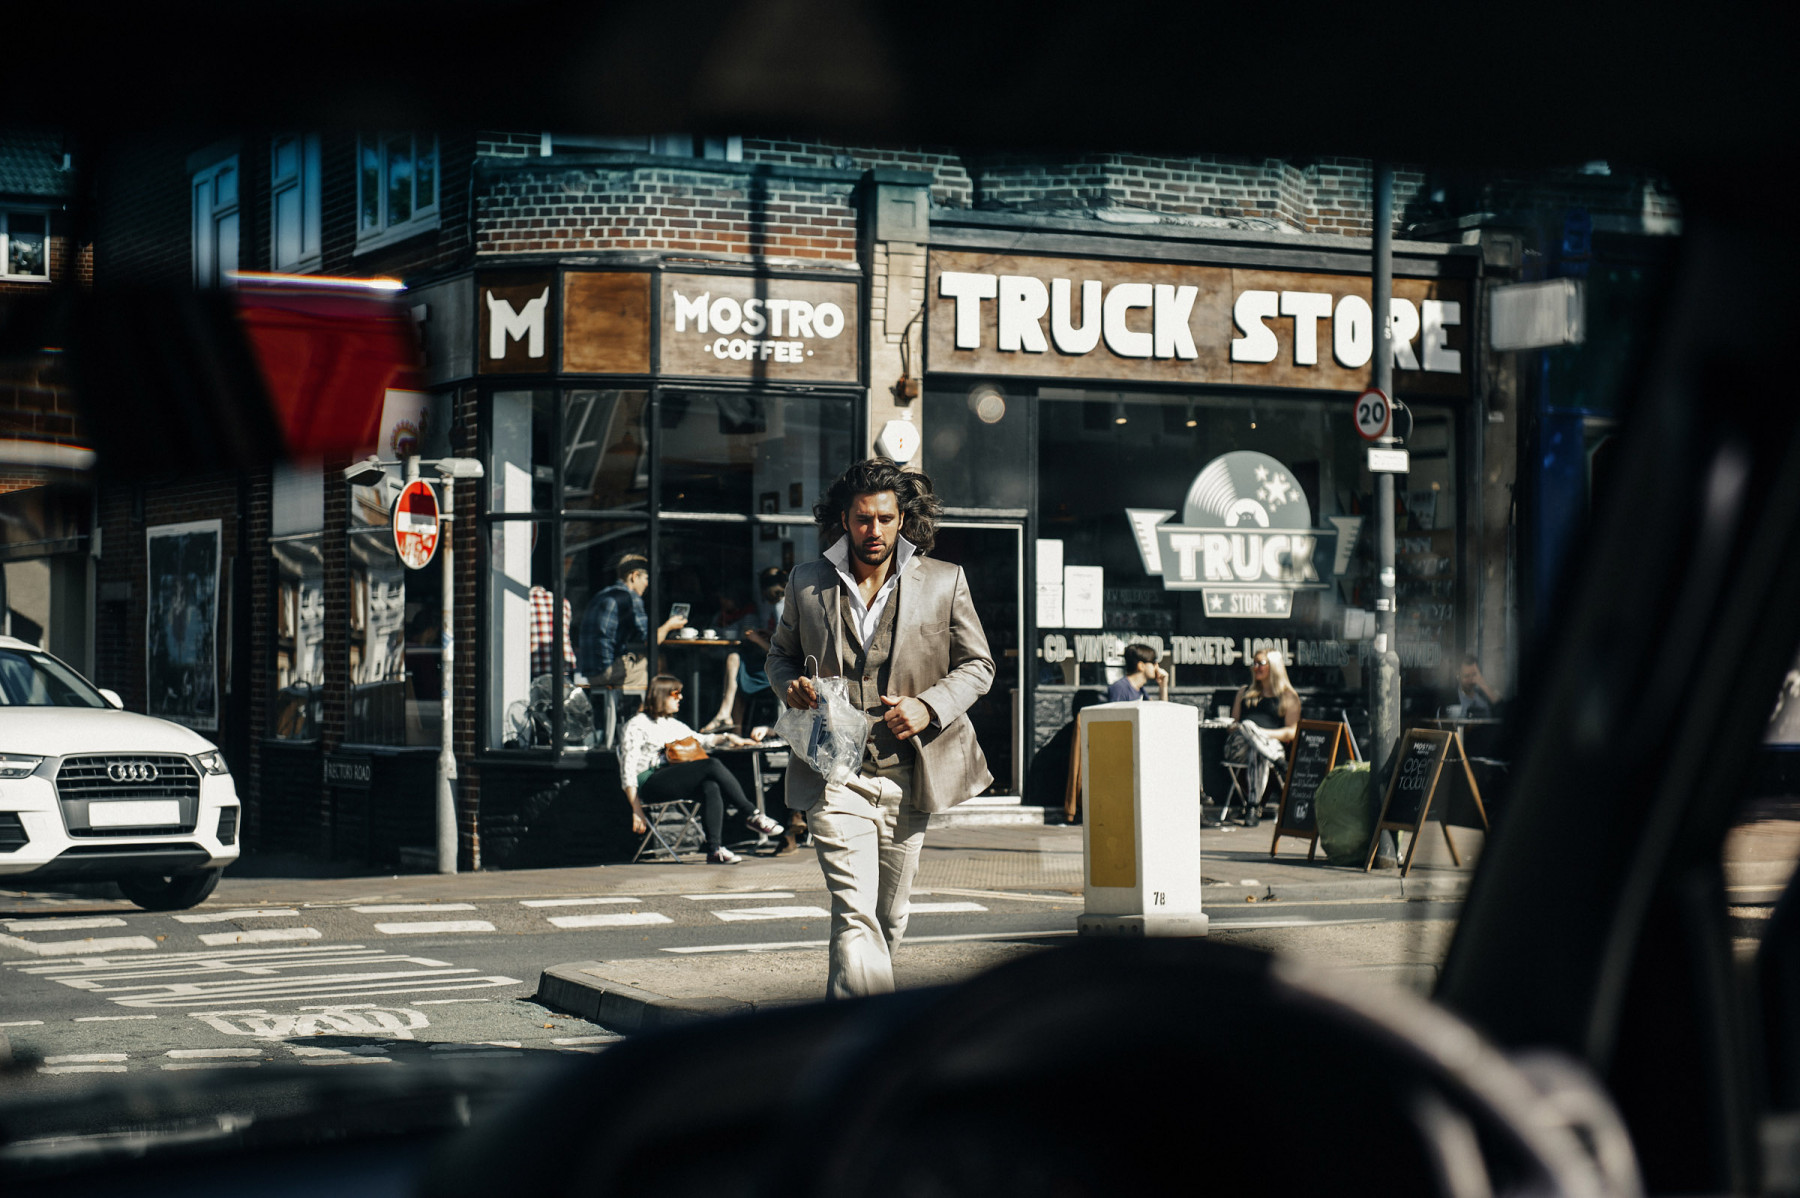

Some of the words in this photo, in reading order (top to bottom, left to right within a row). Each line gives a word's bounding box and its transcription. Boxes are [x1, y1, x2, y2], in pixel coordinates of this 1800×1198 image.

[673, 289, 845, 340] MOSTRO
[940, 271, 1200, 360] TRUCK
[1231, 289, 1462, 375] STORE
[711, 338, 805, 364] COFFEE
[1359, 401, 1385, 426] 20
[1169, 533, 1320, 582] TRUCK
[1229, 593, 1268, 614] STORE
[1170, 635, 1236, 666] TICKETS
[1153, 891, 1166, 906] 78
